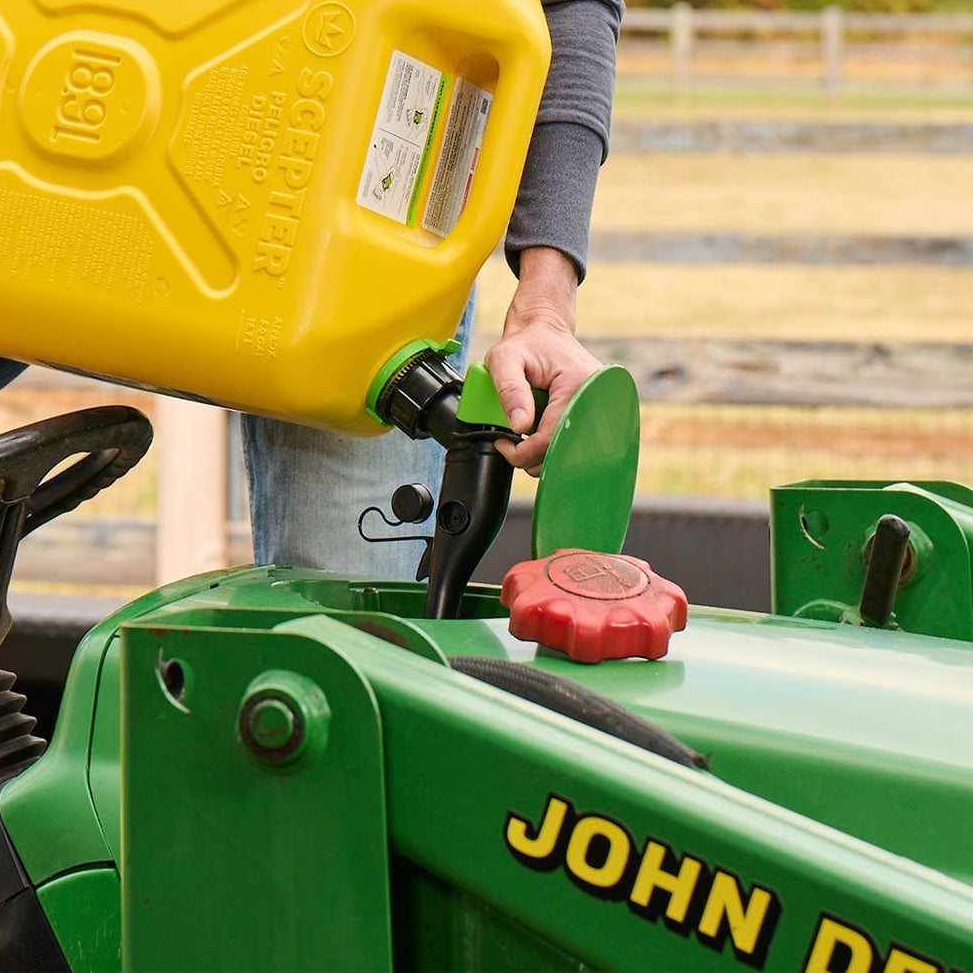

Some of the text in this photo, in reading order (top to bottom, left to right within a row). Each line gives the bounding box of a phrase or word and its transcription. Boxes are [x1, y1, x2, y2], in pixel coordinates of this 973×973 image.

[235, 94, 268, 171] DIESEL
[251, 90, 286, 183] PELIGRO
[504, 793, 784, 971] JOHN
